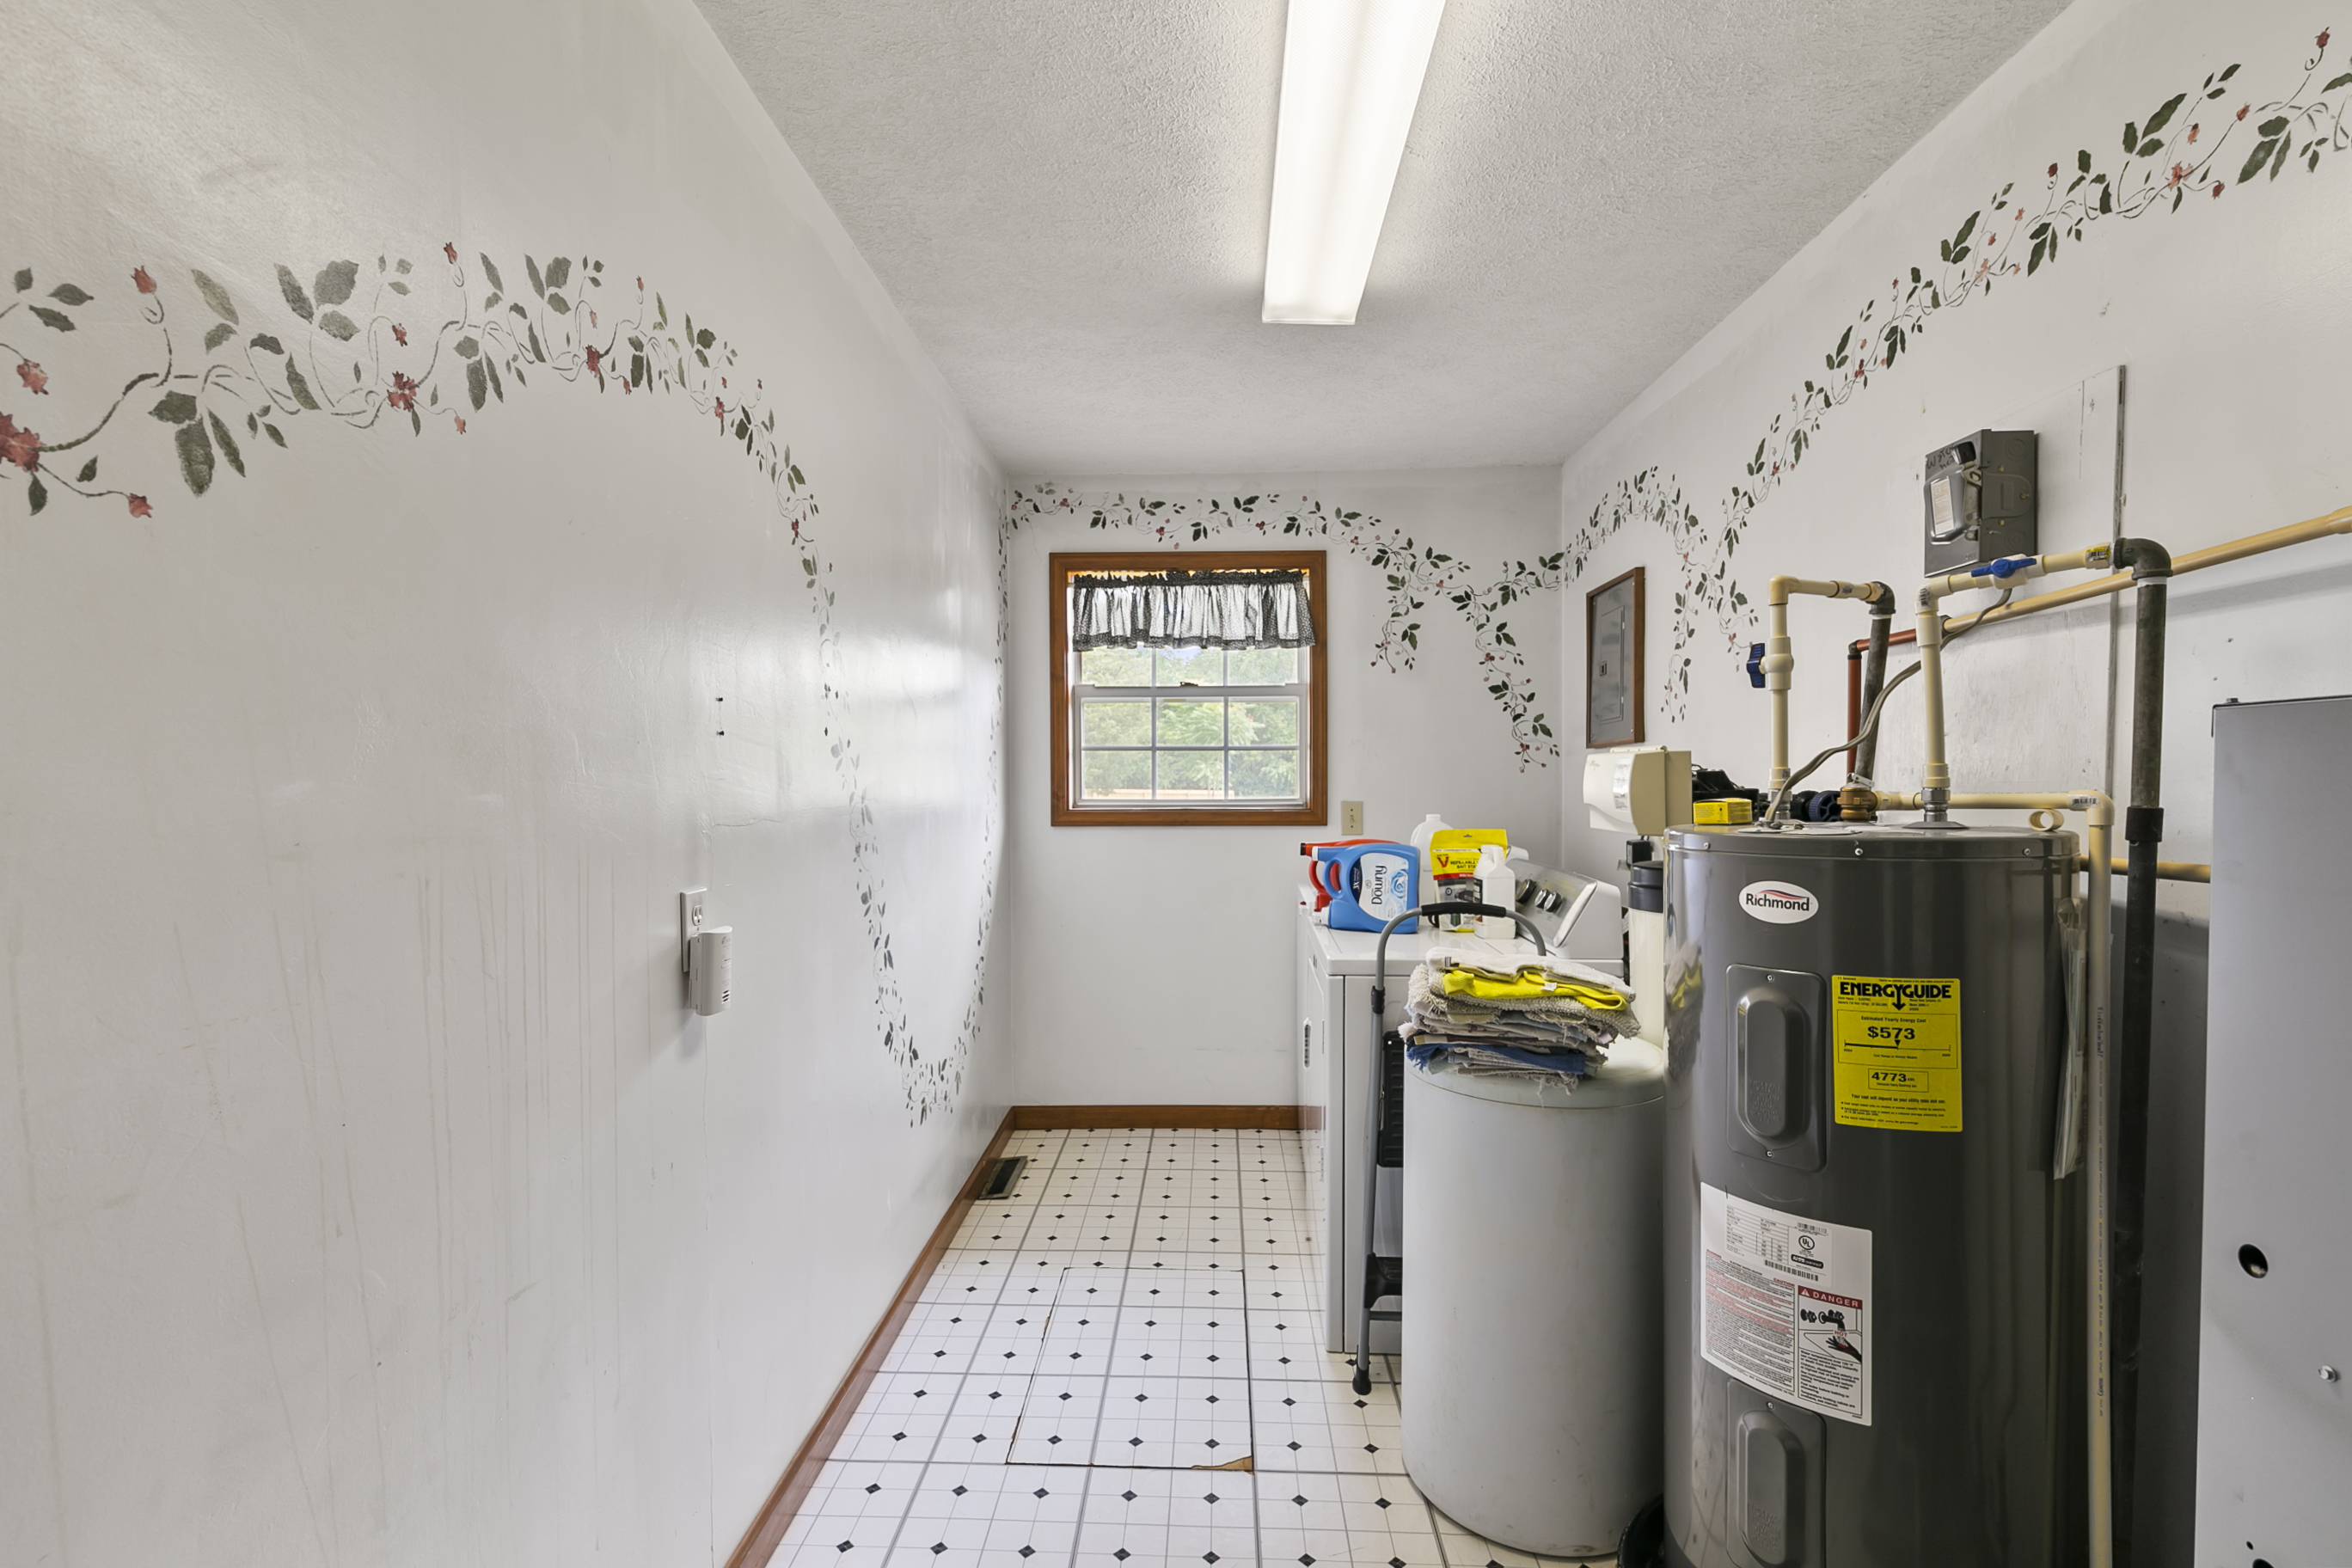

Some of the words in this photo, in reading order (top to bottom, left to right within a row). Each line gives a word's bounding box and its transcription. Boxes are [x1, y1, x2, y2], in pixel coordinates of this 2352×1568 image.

[1371, 865, 1387, 904] Downy
[1746, 892, 1810, 911] Richmond
[1840, 981, 1952, 999] ENERGYGUIDE
[1867, 1026, 1915, 1040] $573
[1871, 1072, 1907, 1082] 4773
[1813, 1291, 1859, 1308] DANGER
